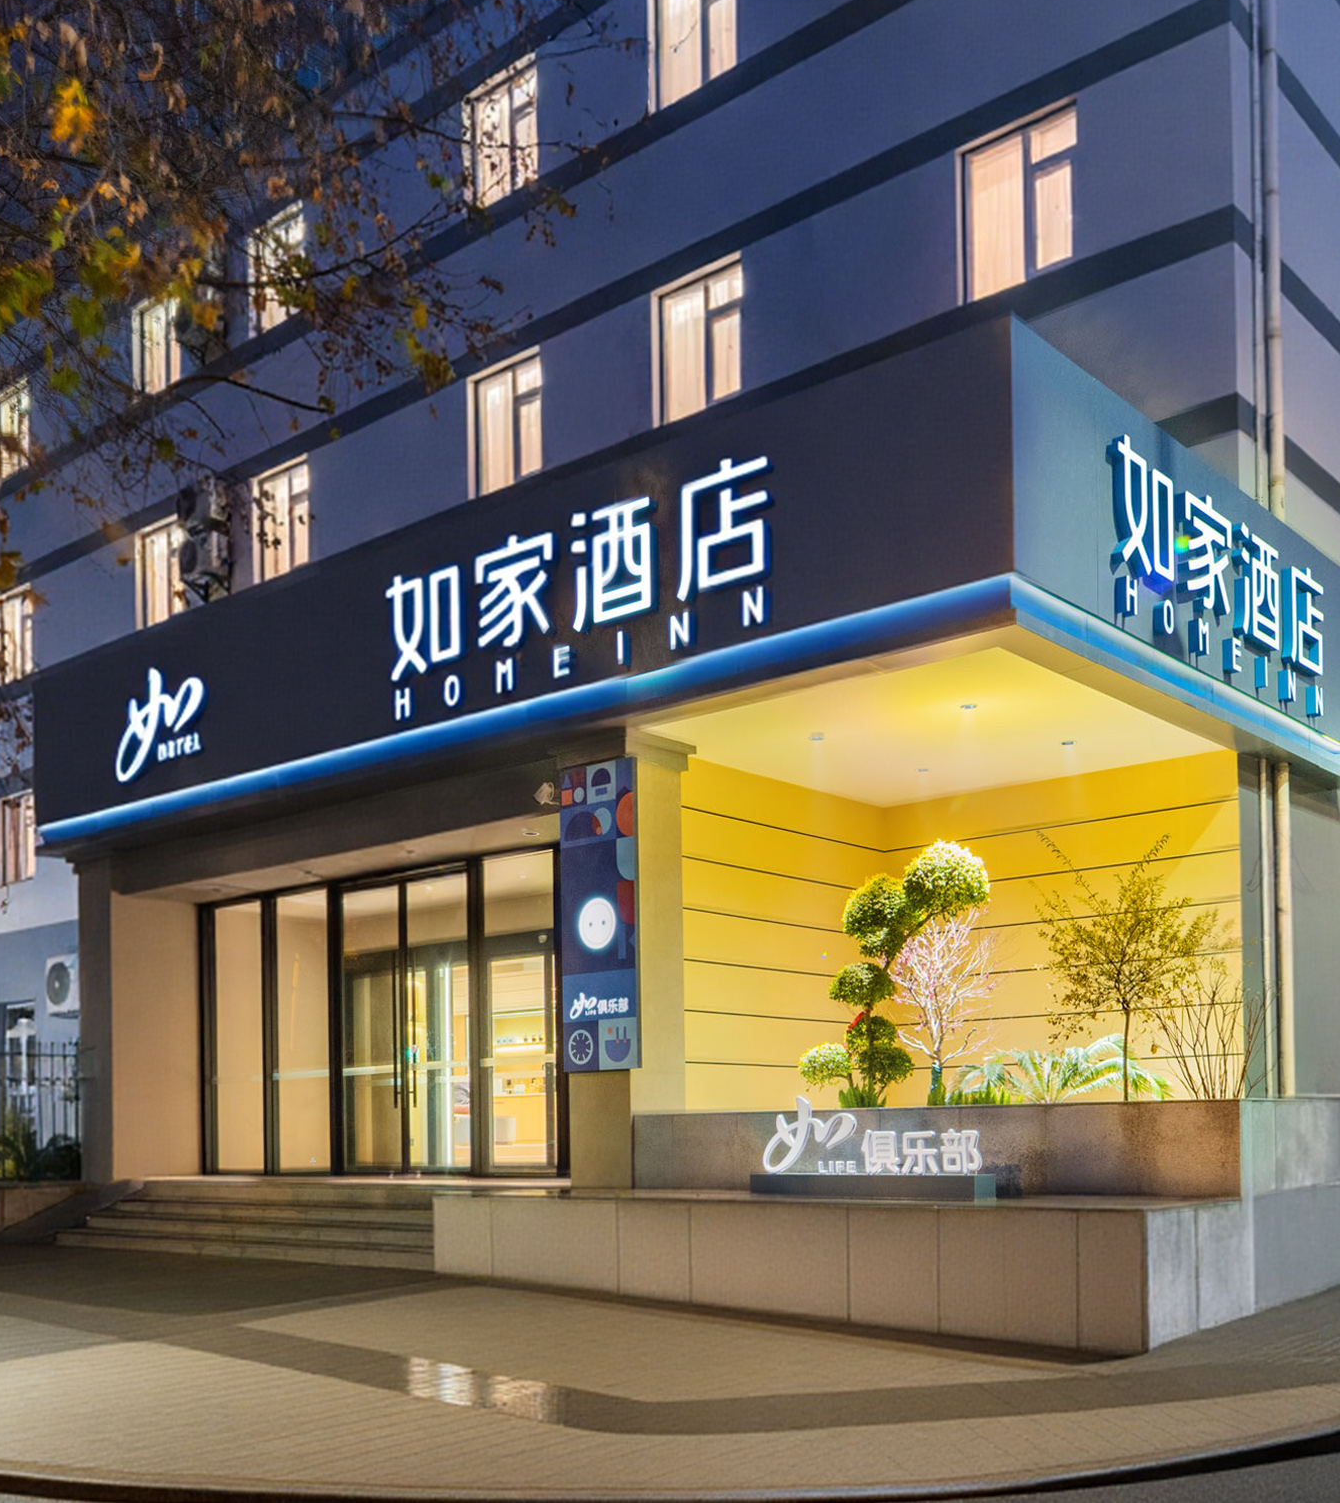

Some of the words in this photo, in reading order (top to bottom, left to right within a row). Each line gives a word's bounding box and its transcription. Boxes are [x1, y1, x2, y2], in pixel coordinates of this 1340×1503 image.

[386, 455, 770, 681] 如家酒店
[1113, 434, 1324, 676] 如家酒店
[597, 997, 629, 1015] 俱乐部
[817, 1160, 857, 1174] LIFE
[861, 1128, 984, 1176] 俱乐部
